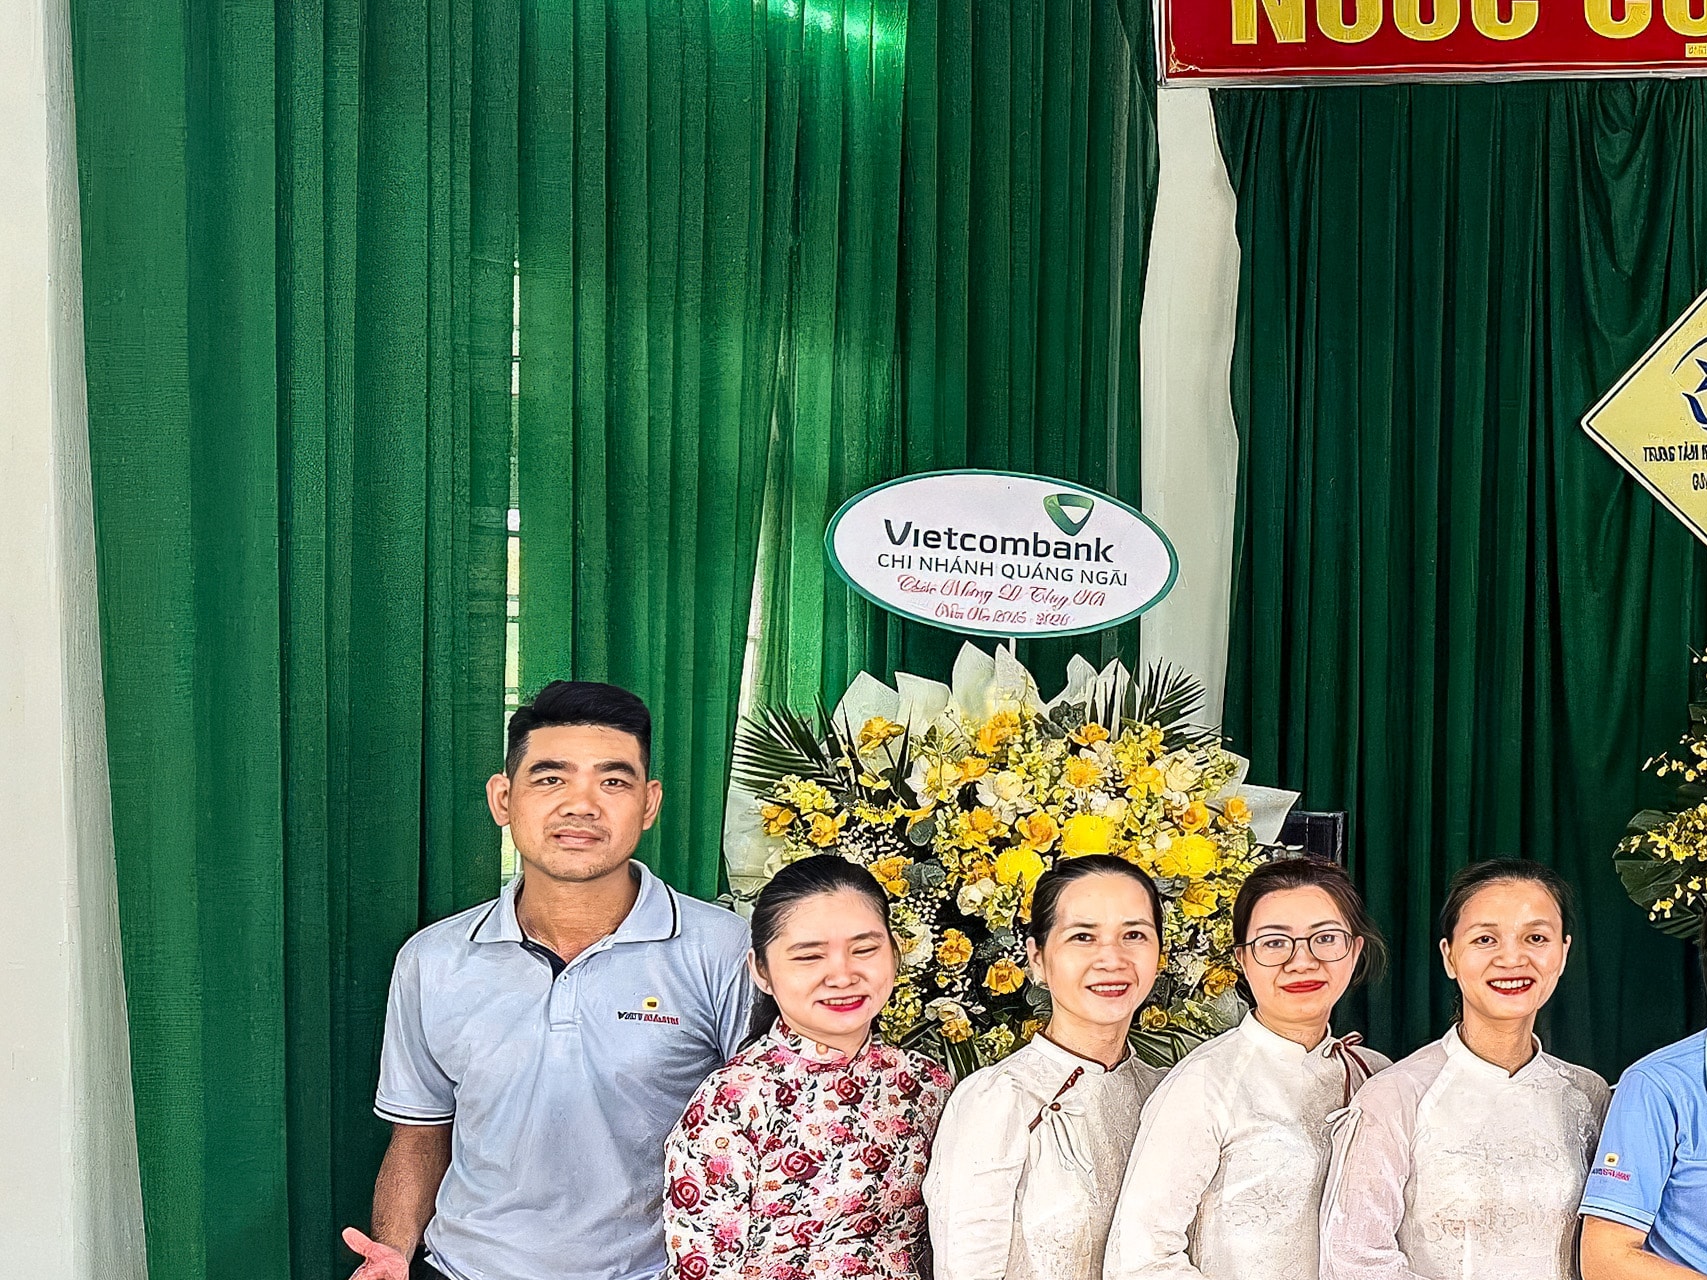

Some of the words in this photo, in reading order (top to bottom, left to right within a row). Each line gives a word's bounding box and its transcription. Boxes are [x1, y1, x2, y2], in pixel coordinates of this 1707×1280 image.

[884, 518, 1115, 563] Vietcombank
[878, 553, 912, 571] CHI
[919, 555, 994, 577] NHÁNH
[1080, 569, 1128, 587] NGÃI
